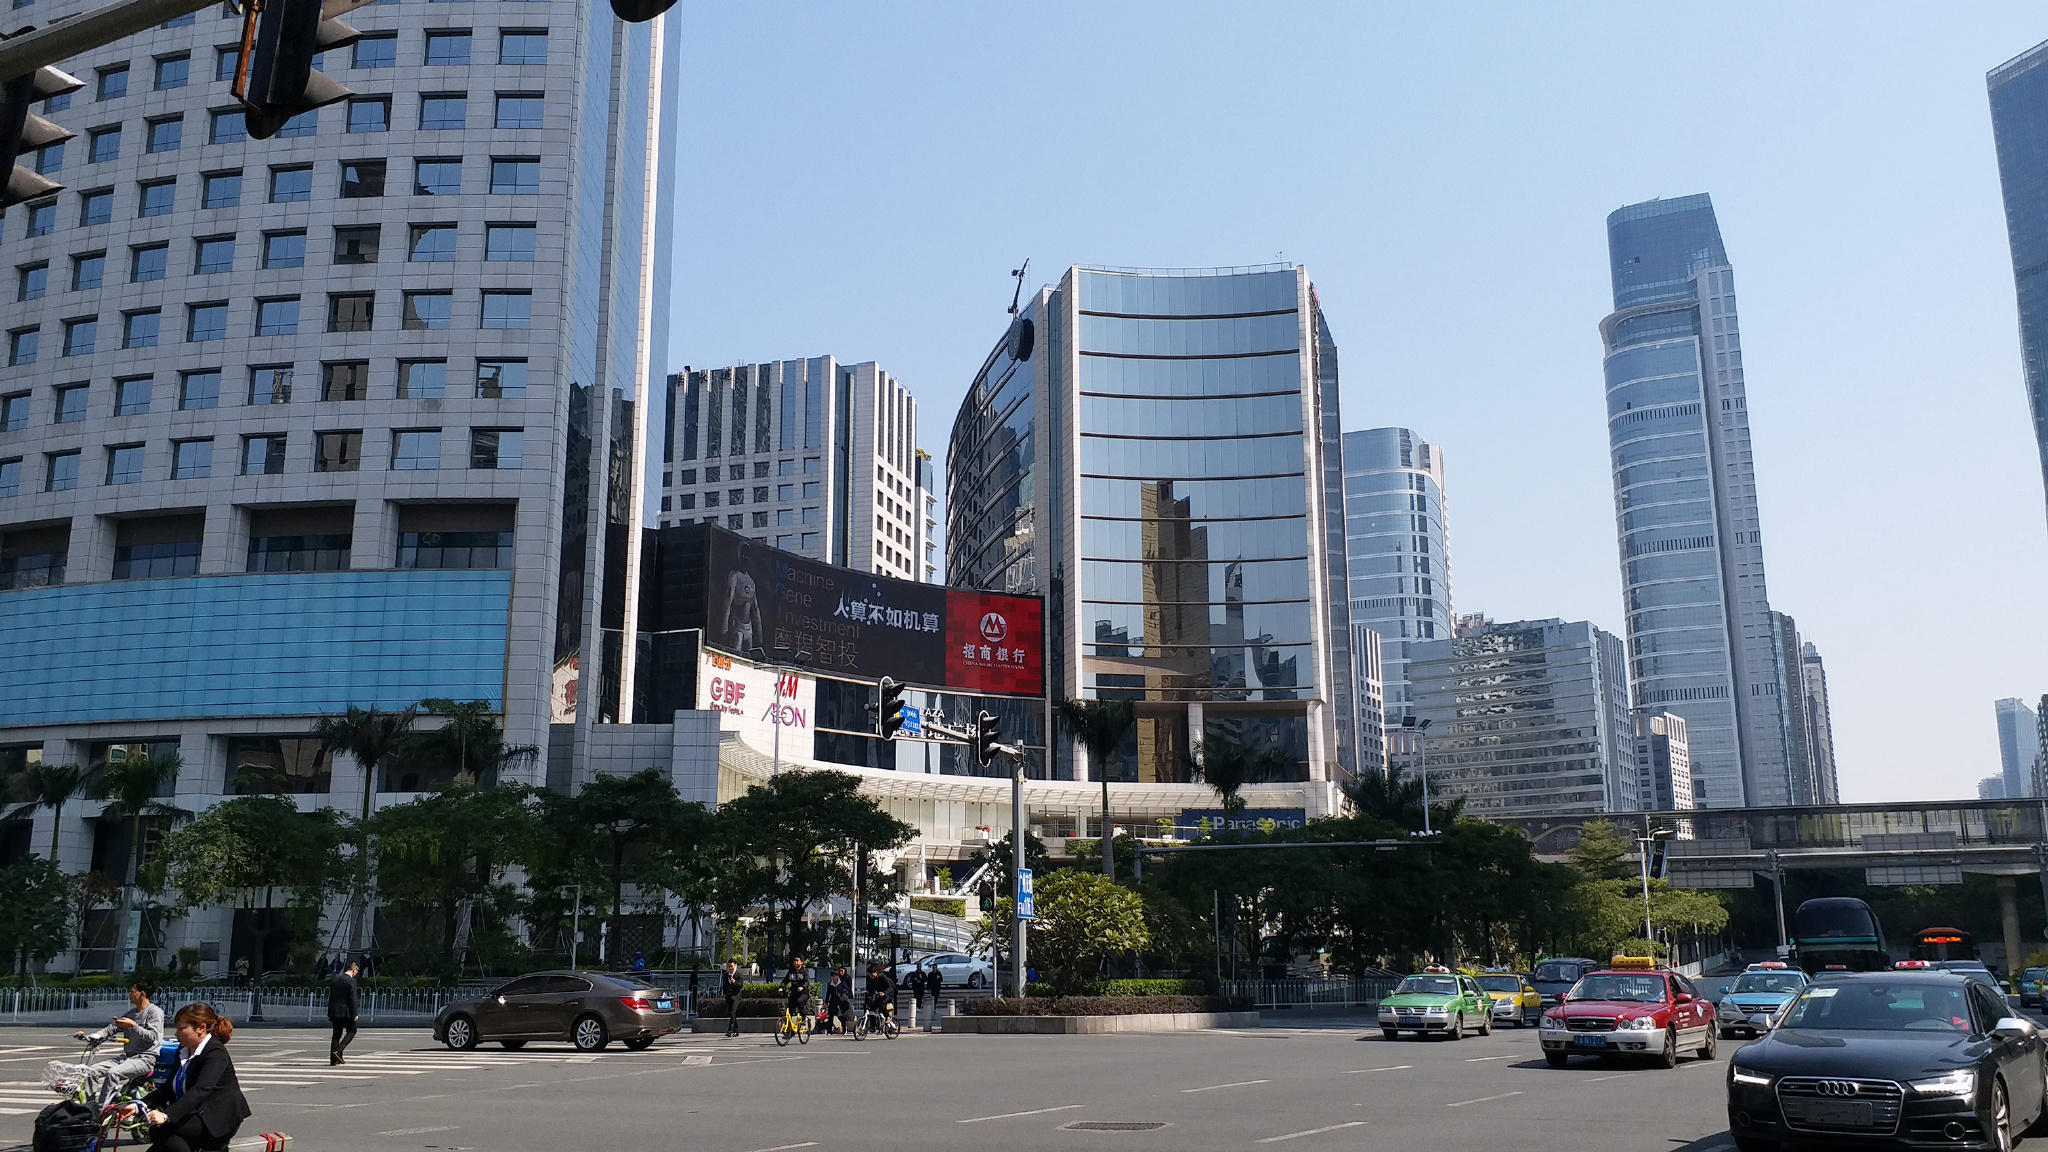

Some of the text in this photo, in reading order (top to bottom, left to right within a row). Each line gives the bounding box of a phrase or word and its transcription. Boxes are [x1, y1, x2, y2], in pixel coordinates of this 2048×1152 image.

[775, 559, 834, 591] Machine
[775, 582, 812, 608] Gene
[777, 604, 860, 639] Investment
[833, 597, 940, 634] 人算不如机算
[710, 676, 746, 706] GBF
[774, 673, 800, 700] H&M
[919, 707, 945, 718] LAZA
[1213, 815, 1301, 831] Panasonic
